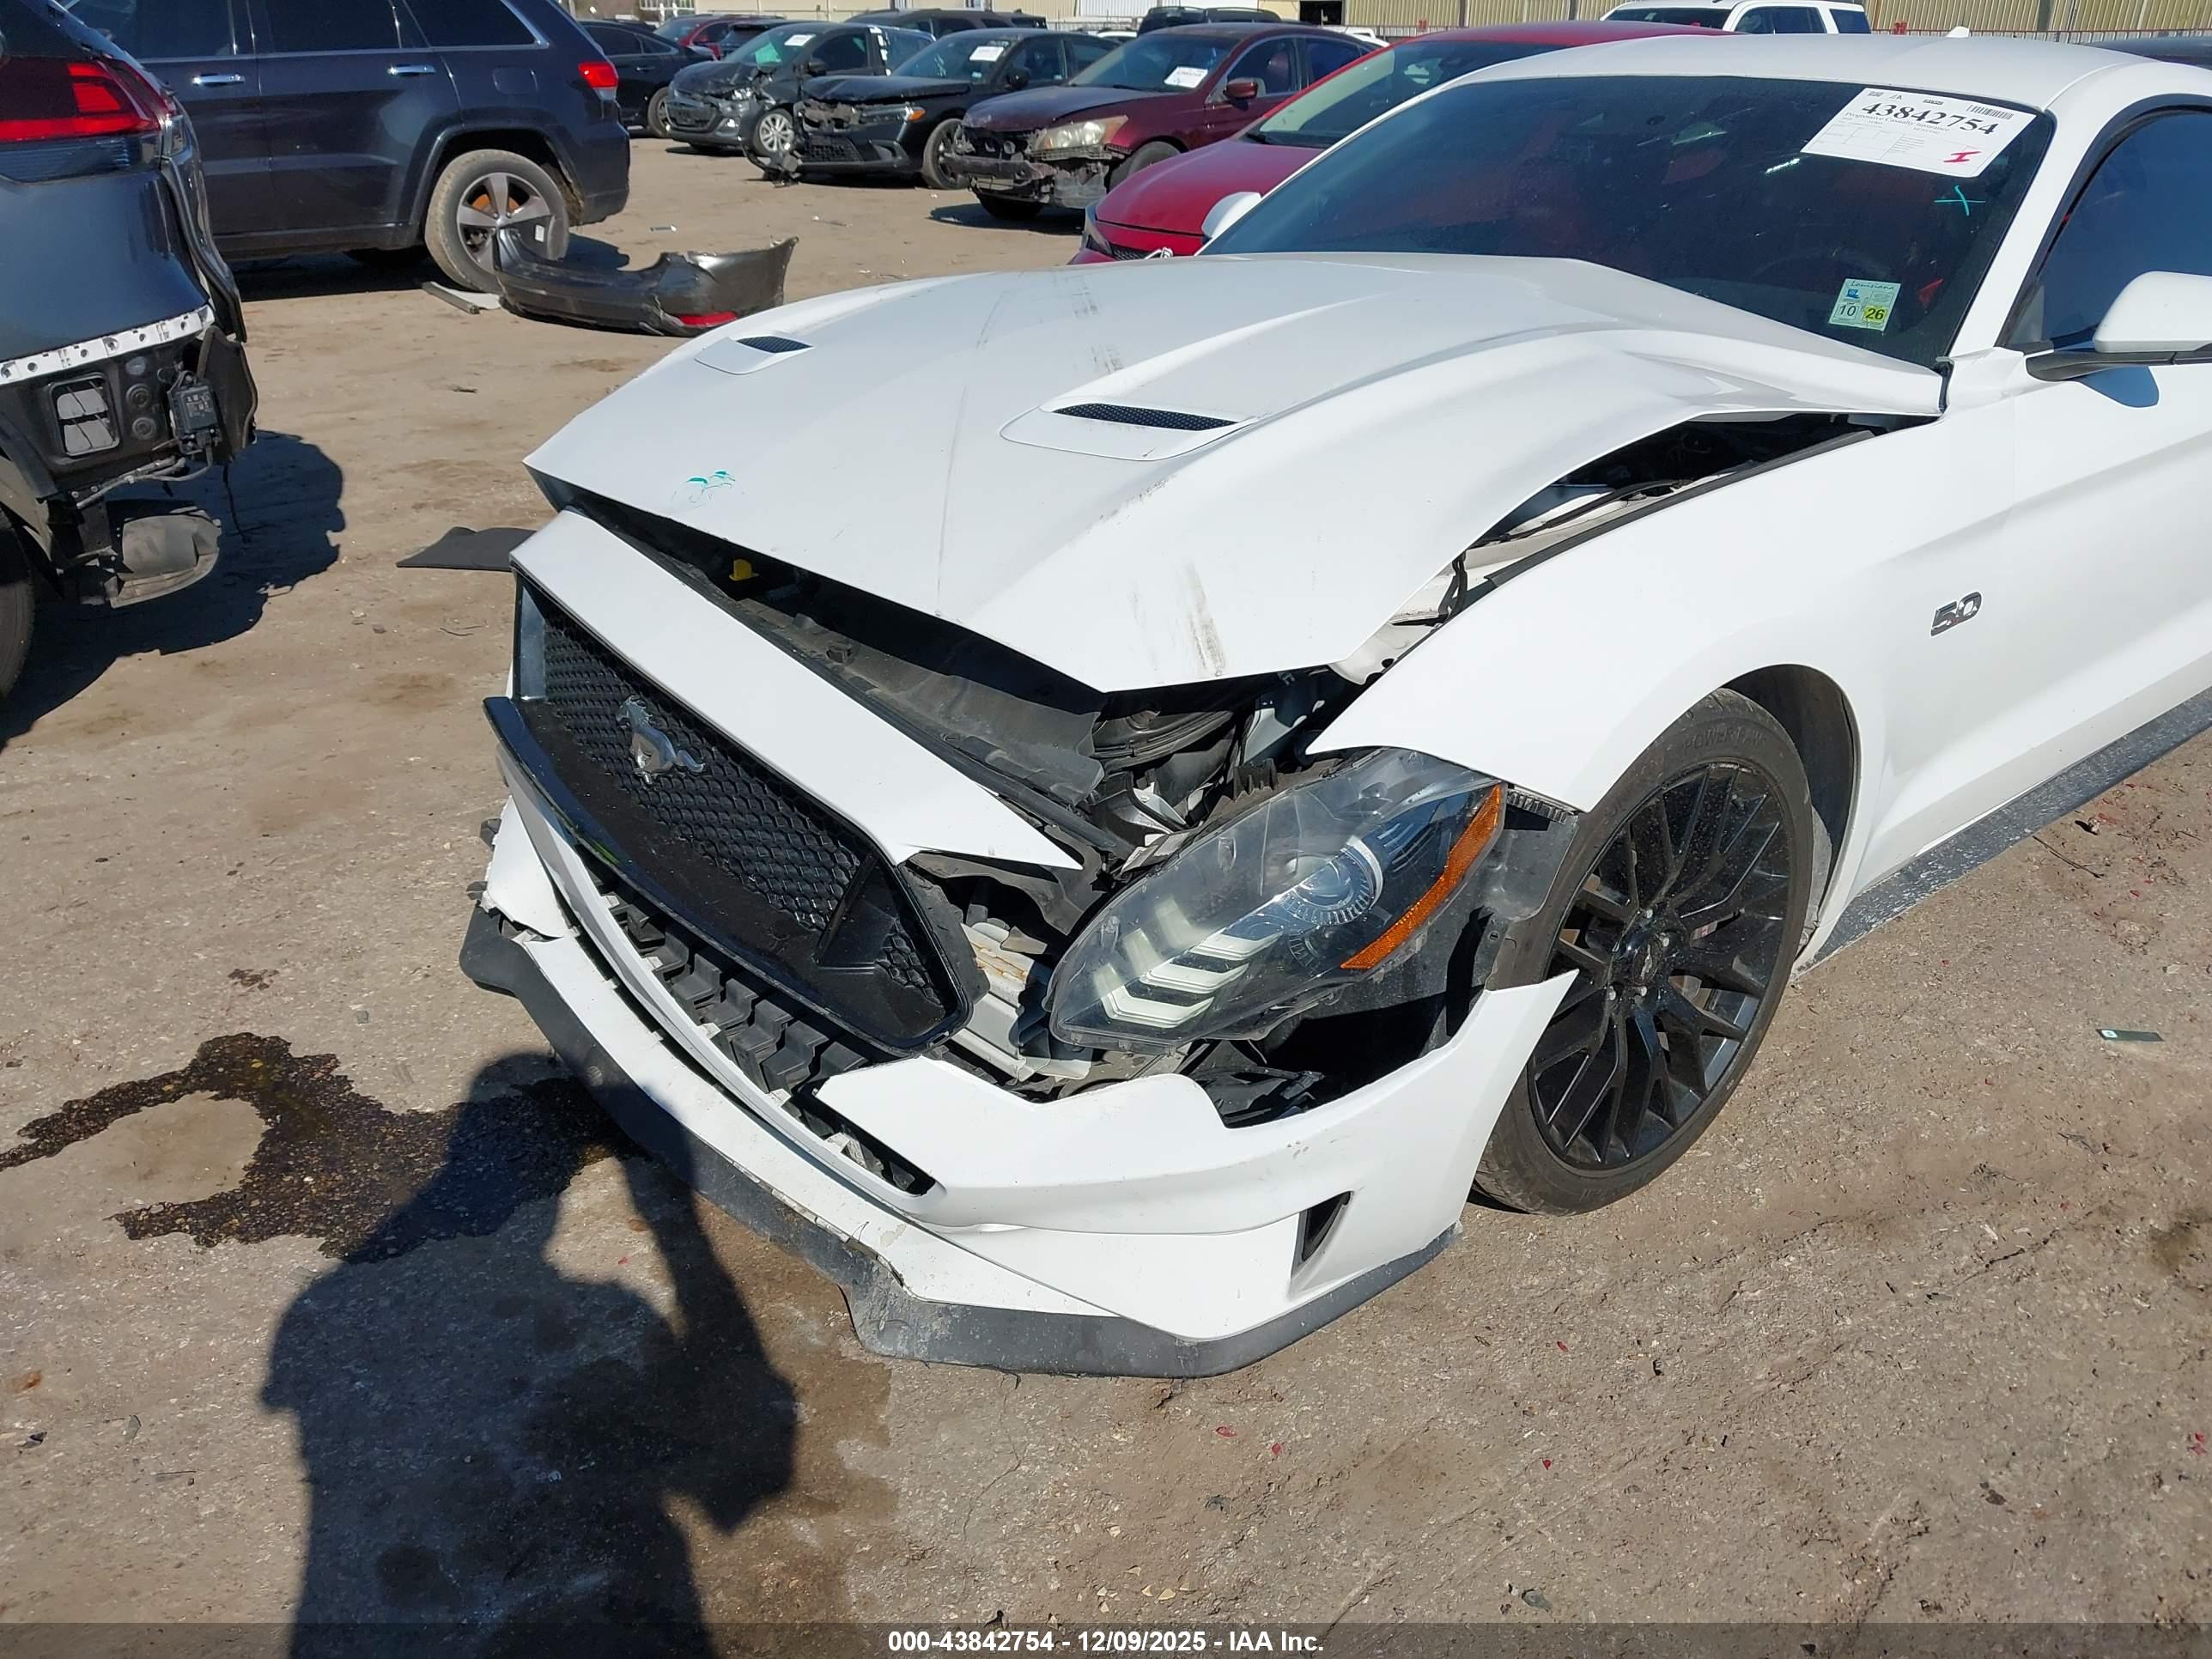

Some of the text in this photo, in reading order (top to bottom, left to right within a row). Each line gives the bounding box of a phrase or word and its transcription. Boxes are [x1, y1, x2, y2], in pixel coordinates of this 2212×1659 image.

[1845, 112, 1884, 121] Progressive
[1862, 103, 1999, 135] 43842754
[1850, 280, 1895, 290] Louisiana
[1840, 305, 1856, 317] 10
[1865, 307, 1885, 320] 26
